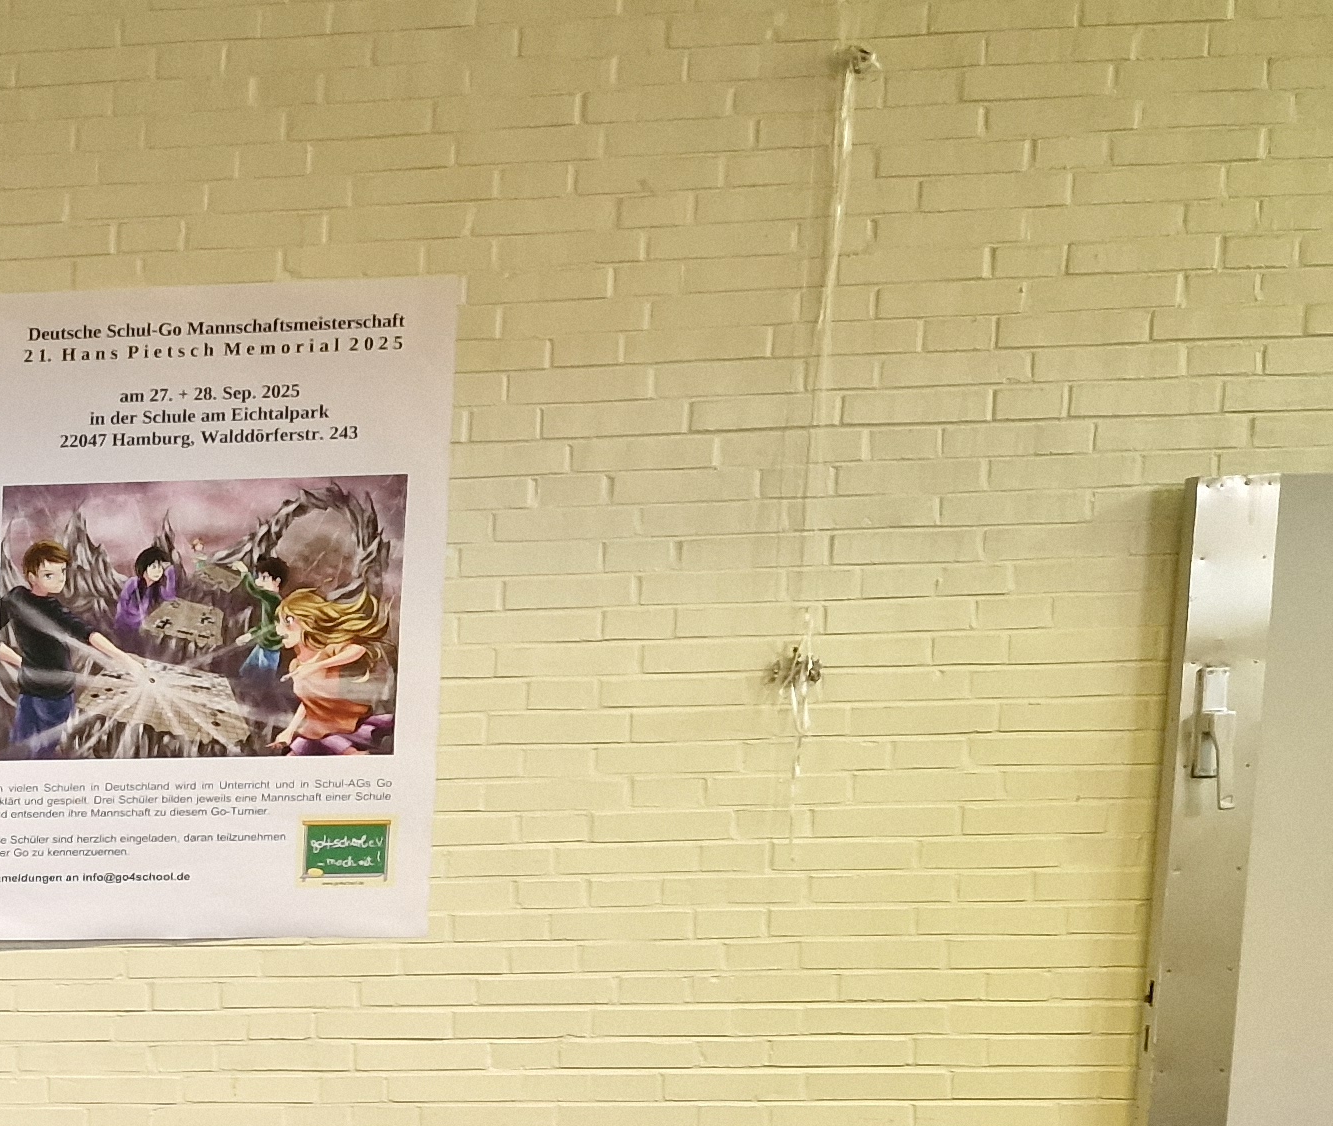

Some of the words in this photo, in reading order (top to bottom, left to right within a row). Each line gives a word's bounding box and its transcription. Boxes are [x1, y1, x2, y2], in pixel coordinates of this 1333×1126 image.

[28, 325, 102, 342] Deutsche
[107, 322, 182, 340] Schul-Go
[187, 313, 405, 337] Mannschaftsmeisterschaft
[23, 347, 53, 363] 21.
[62, 346, 119, 362] Hans
[128, 343, 214, 360] Pietsch
[223, 337, 341, 358] Memorial
[349, 335, 404, 352] 2025
[120, 391, 145, 404] am
[149, 388, 173, 403] 27.
[178, 389, 189, 400] +
[194, 386, 217, 401] 28.
[222, 385, 257, 404] Sep.
[262, 384, 300, 400] 2025
[89, 410, 106, 426] in
[110, 410, 138, 425] der
[142, 408, 195, 425] Schule
[200, 411, 227, 423] am
[231, 404, 330, 425] Eichtalpark
[59, 433, 107, 449] 22047
[111, 430, 195, 450] Hamburg,
[200, 426, 324, 445] Walddörferstr.
[329, 425, 358, 441] 243
[8, 783, 38, 792] vielen
[43, 783, 85, 792] Schulen
[91, 783, 100, 792] in
[105, 782, 170, 792] Deutschland
[175, 781, 197, 791] wird
[201, 781, 214, 790] im
[219, 780, 270, 790] Unterricht
[275, 780, 295, 789] und
[300, 779, 309, 789] in
[314, 778, 371, 789] Schul-AGs
[376, 778, 392, 788] Go
[24, 797, 44, 806] und
[93, 795, 115, 805] Drei
[118, 794, 159, 805] Schüler
[162, 794, 193, 804] bilden
[195, 793, 232, 805] jeweils
[235, 793, 258, 803] eine
[261, 793, 322, 802] Mannschaft
[325, 792, 351, 802] einer
[354, 791, 392, 802] Schule
[11, 809, 65, 818] entsenden
[68, 809, 87, 818] ihre
[90, 808, 151, 818] Mannschaft
[154, 809, 166, 817] zu
[170, 807, 208, 817] diesem
[10, 834, 49, 844] Schüler
[52, 834, 73, 844] sind
[76, 834, 117, 843] herzlich
[119, 833, 180, 845] eingeladen,
[184, 833, 214, 842] daran
[217, 832, 286, 842] teilzunehmen
[13, 847, 29, 857] Go
[32, 849, 44, 857] zu
[65, 873, 79, 882] an
[82, 872, 191, 884] info@go4school.de
